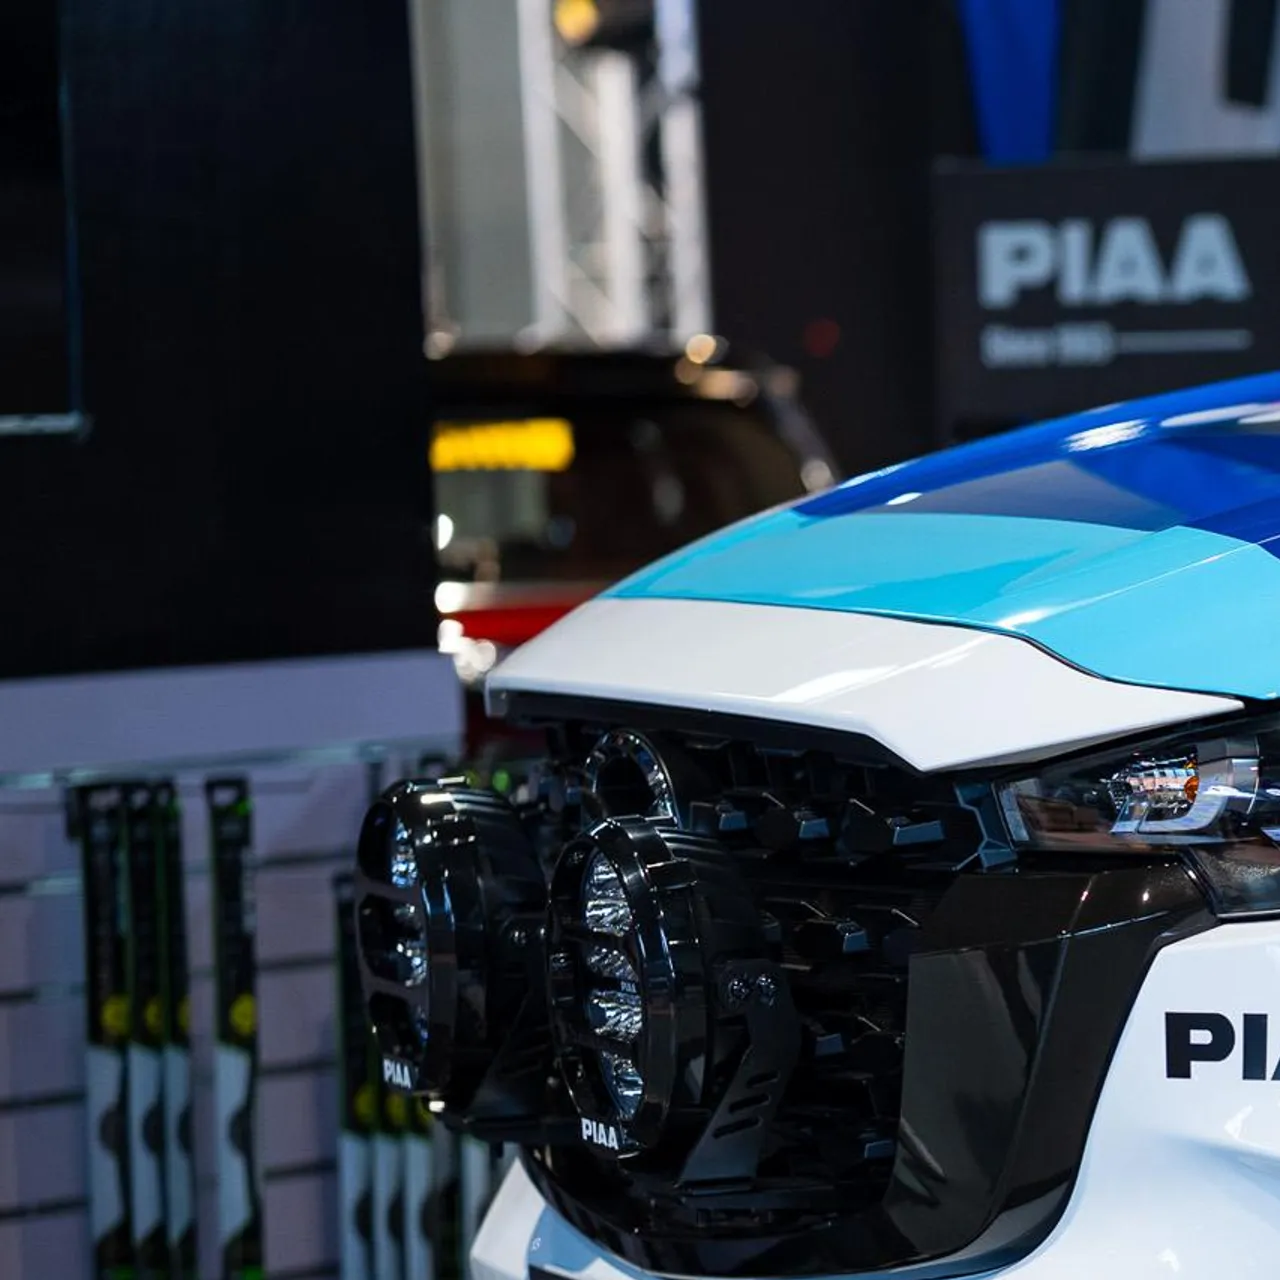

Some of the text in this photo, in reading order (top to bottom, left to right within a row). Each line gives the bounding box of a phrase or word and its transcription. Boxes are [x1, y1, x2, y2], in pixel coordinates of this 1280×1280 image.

[978, 213, 1252, 308] PIAA
[383, 1058, 411, 1089] PIAA
[581, 1117, 619, 1150] PIAA
